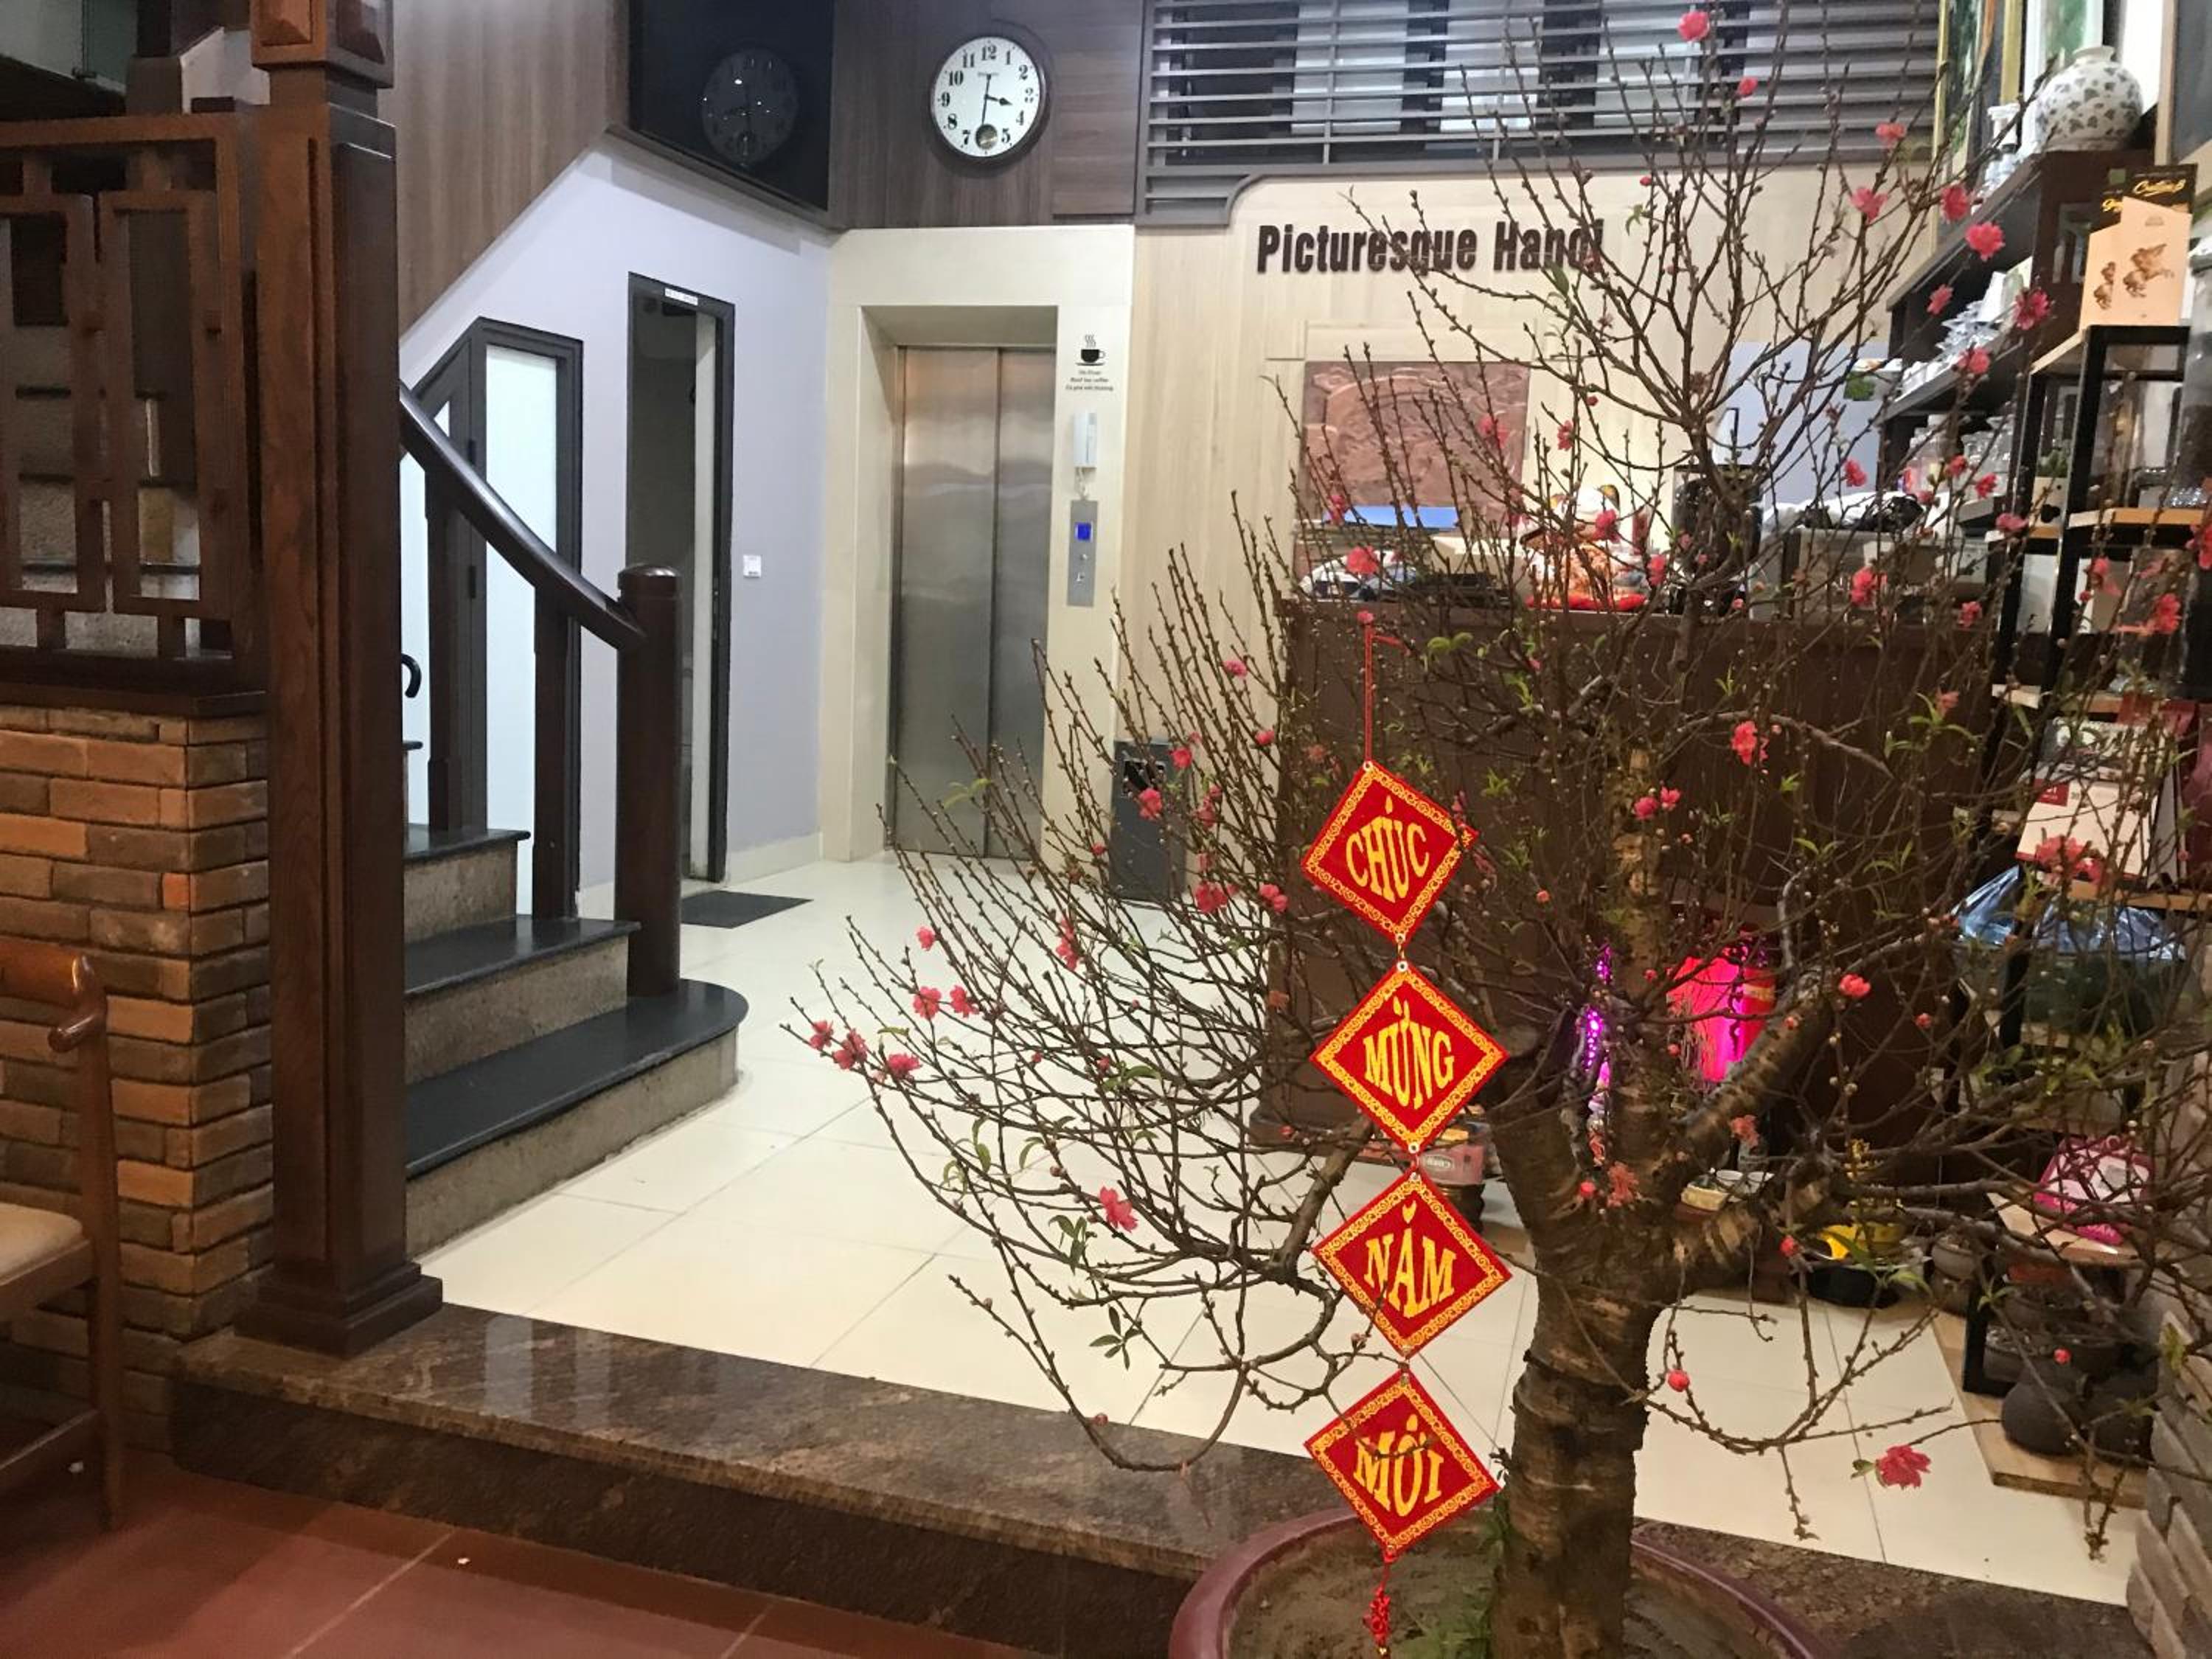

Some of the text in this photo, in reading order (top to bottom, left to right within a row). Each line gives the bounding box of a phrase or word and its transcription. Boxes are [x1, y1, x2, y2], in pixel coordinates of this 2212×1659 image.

[962, 52, 975, 68] 11
[981, 45, 997, 61] 12
[1005, 50, 1011, 65] 1
[948, 70, 964, 86] 10
[1018, 65, 1028, 80] 2
[941, 92, 950, 107] 9
[947, 114, 958, 130] 8
[962, 130, 971, 145] 7
[1001, 128, 1011, 144] 5
[1257, 223, 1478, 276] Picturesque
[1346, 796, 1430, 904] CHÚC
[1363, 995, 1455, 1110] MỪNG
[1364, 1200, 1457, 1318] NĂM
[1352, 1413, 1444, 1517] MỚI
